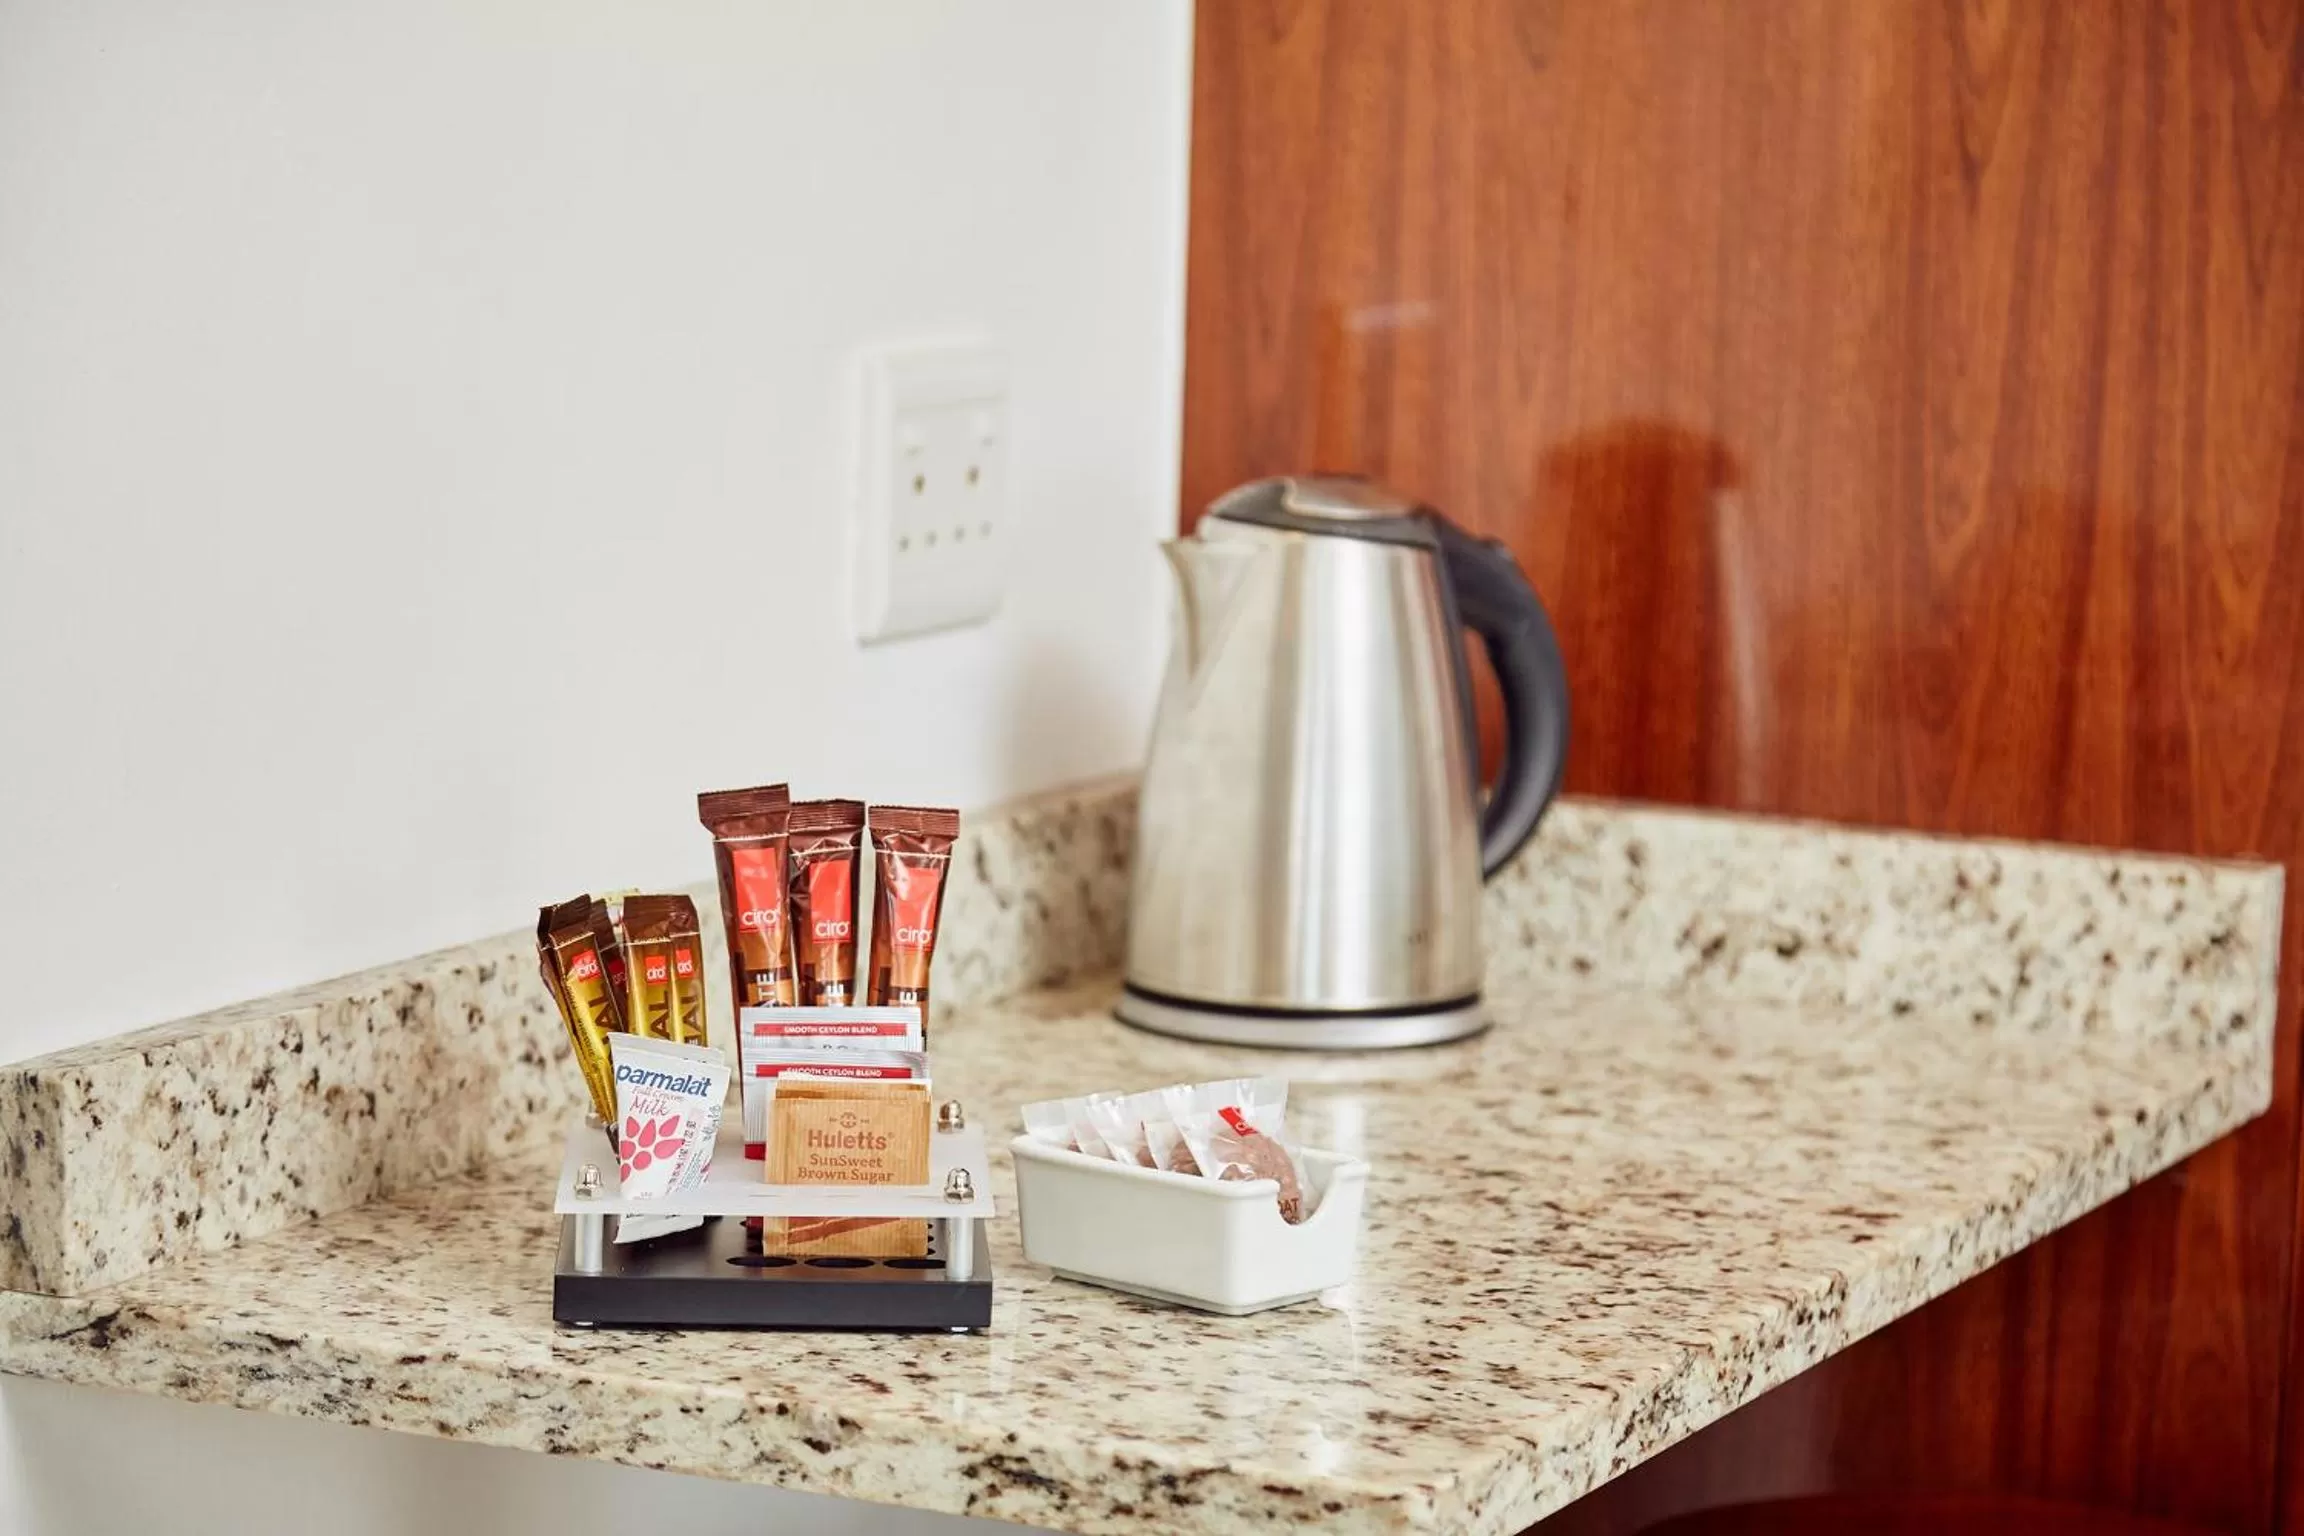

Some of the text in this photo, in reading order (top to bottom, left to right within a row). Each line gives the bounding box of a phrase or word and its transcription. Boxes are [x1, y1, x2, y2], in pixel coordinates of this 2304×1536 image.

[742, 907, 779, 926] ciro
[815, 921, 849, 937] ciro
[896, 928, 931, 944] ciro
[616, 1064, 711, 1097] parmalat
[823, 1068, 854, 1076] CEYLON
[856, 1069, 882, 1077] BLEND
[630, 1095, 669, 1116] Milk
[807, 1130, 887, 1150] Huletts
[810, 1153, 882, 1168] SunSweet
[798, 1167, 894, 1184] Brown Sugar
